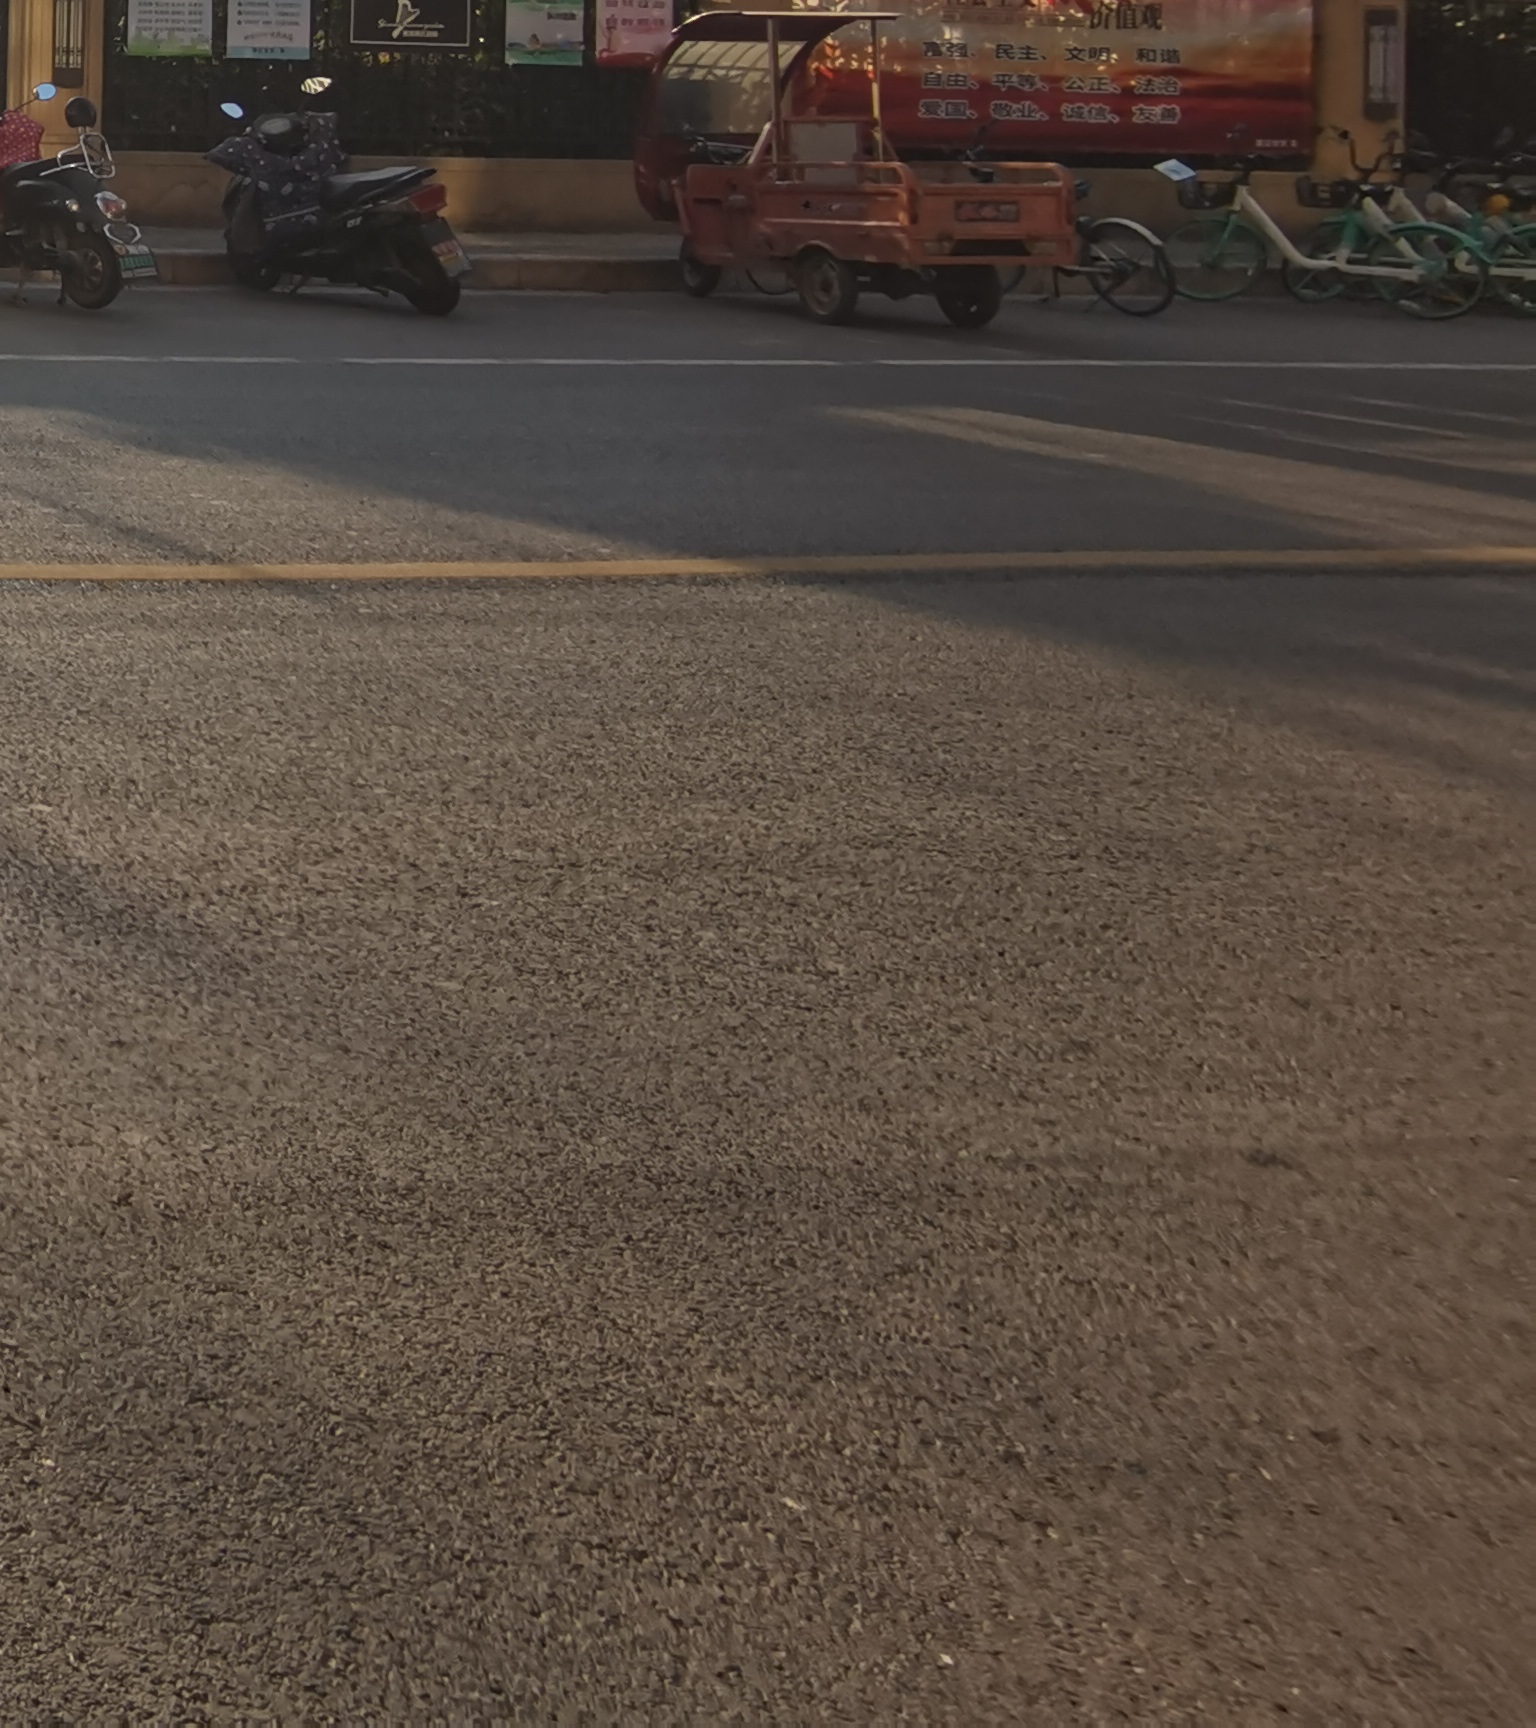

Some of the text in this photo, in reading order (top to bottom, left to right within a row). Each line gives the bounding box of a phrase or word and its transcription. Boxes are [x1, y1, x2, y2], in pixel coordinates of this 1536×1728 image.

[1089, 1, 1163, 30] 价值观
[1135, 47, 1181, 65] 和谐
[1134, 76, 1180, 96] 法治
[1132, 103, 1181, 124] 友善
